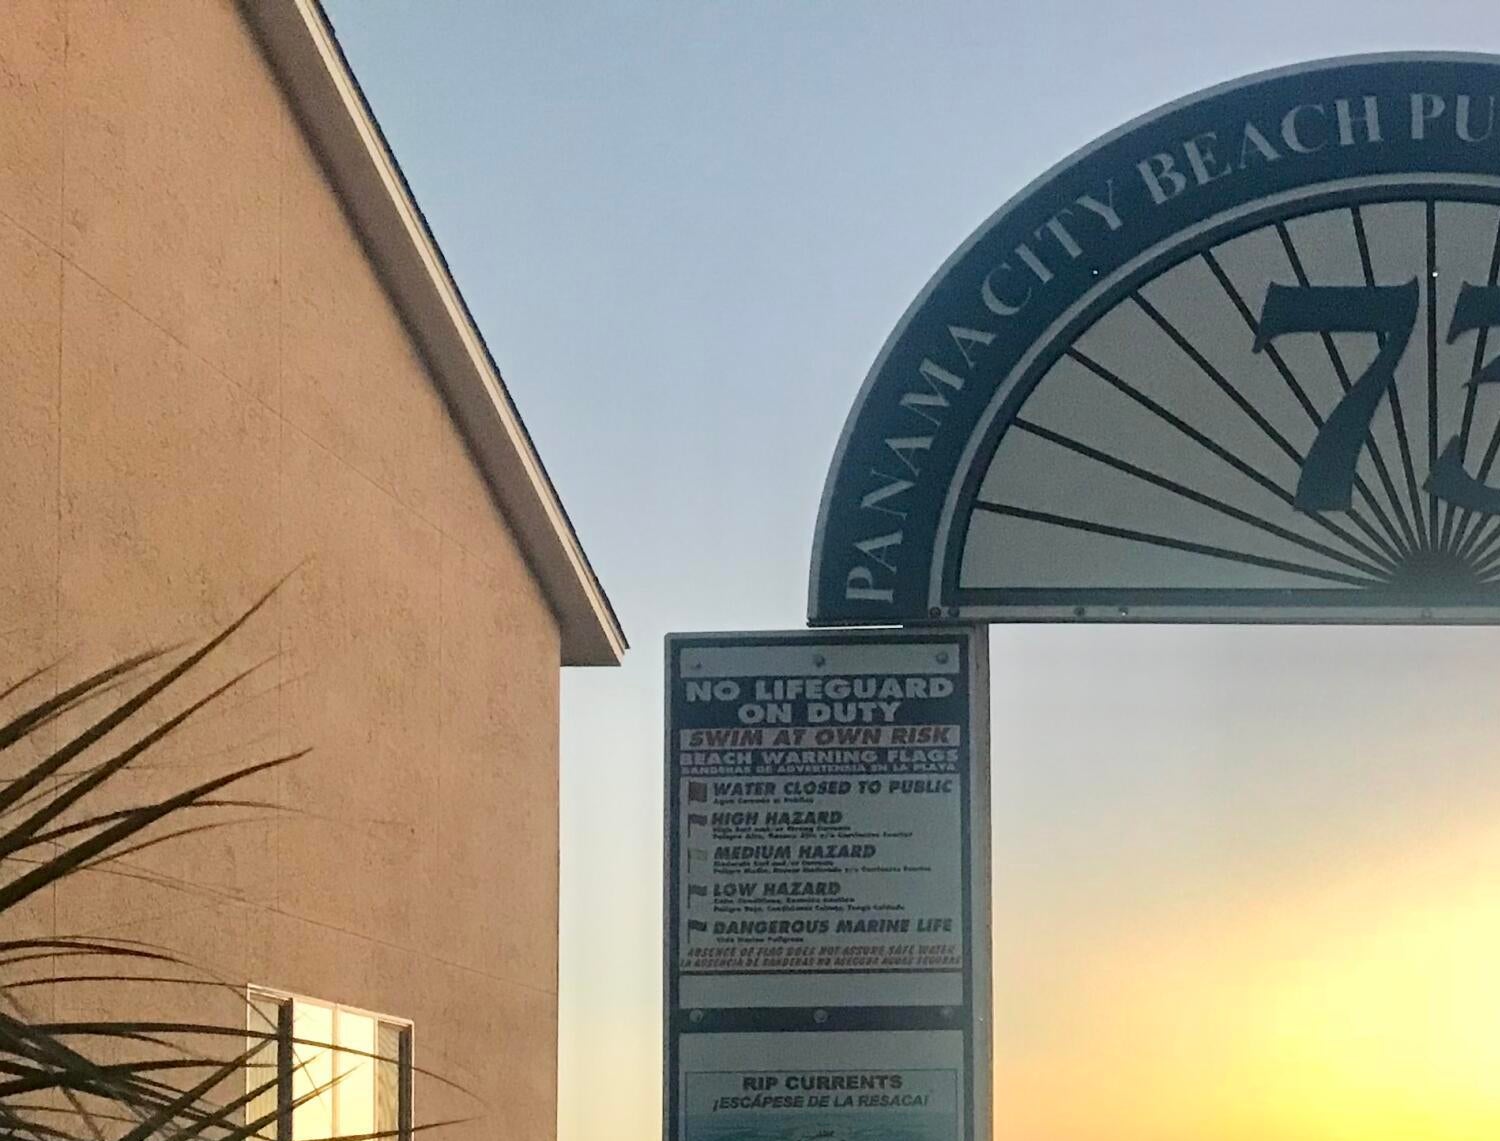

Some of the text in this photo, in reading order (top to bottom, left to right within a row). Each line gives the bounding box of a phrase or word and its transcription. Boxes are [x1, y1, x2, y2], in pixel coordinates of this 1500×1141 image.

[845, 323, 996, 603] PANAMA
[981, 178, 1125, 317] CITY
[1136, 93, 1384, 205] BEACH
[686, 678, 953, 702] NO LIFEGUARD
[738, 702, 900, 723] ON DUTY
[689, 727, 951, 746] SWIM AT OWN RISK
[680, 749, 958, 766] BEACH WARNING FLAGS
[713, 780, 952, 797] WATER CLOSED TO PUBLIC
[712, 811, 843, 826] HIGH HAZARD
[714, 845, 876, 860] MEDIUM HAZARD
[713, 882, 841, 898] LOW HAZARD
[713, 918, 952, 935] DANGEROUS MARINE LIFE
[743, 1075, 904, 1091] RIP CURRENTS
[808, 1096, 829, 1108] DE
[834, 1095, 854, 1107] LA
